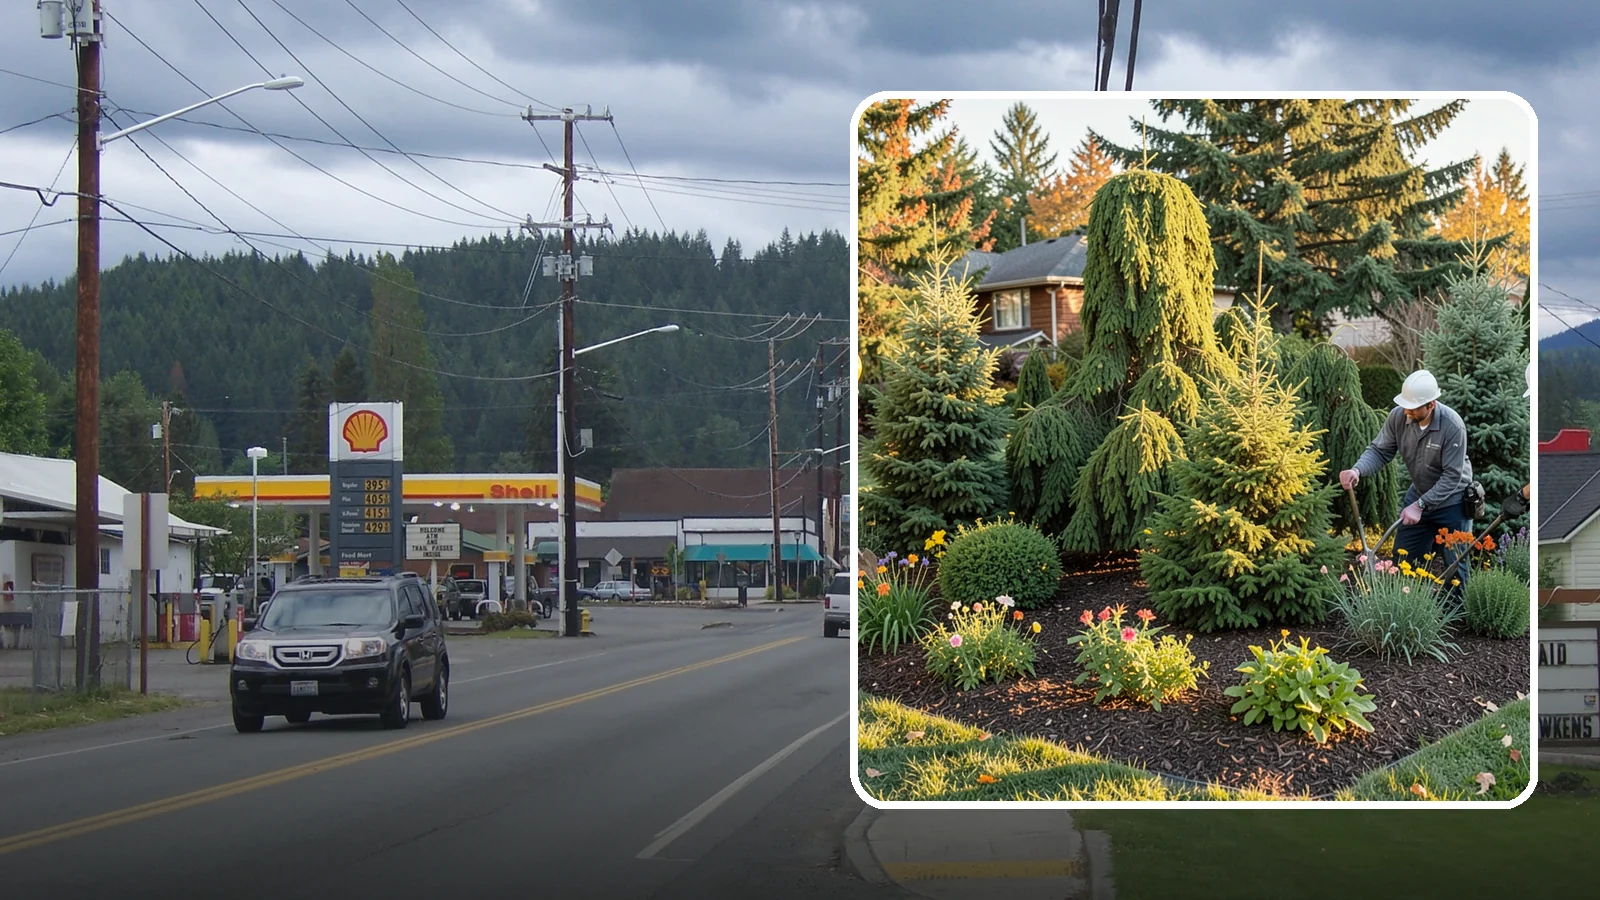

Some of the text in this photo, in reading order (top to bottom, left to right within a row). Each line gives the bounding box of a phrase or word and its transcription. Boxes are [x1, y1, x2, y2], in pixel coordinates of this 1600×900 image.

[366, 480, 384, 490] 395
[490, 484, 547, 499] Shell
[366, 494, 384, 504] 405
[366, 508, 384, 518] 415
[366, 522, 384, 532] 429
